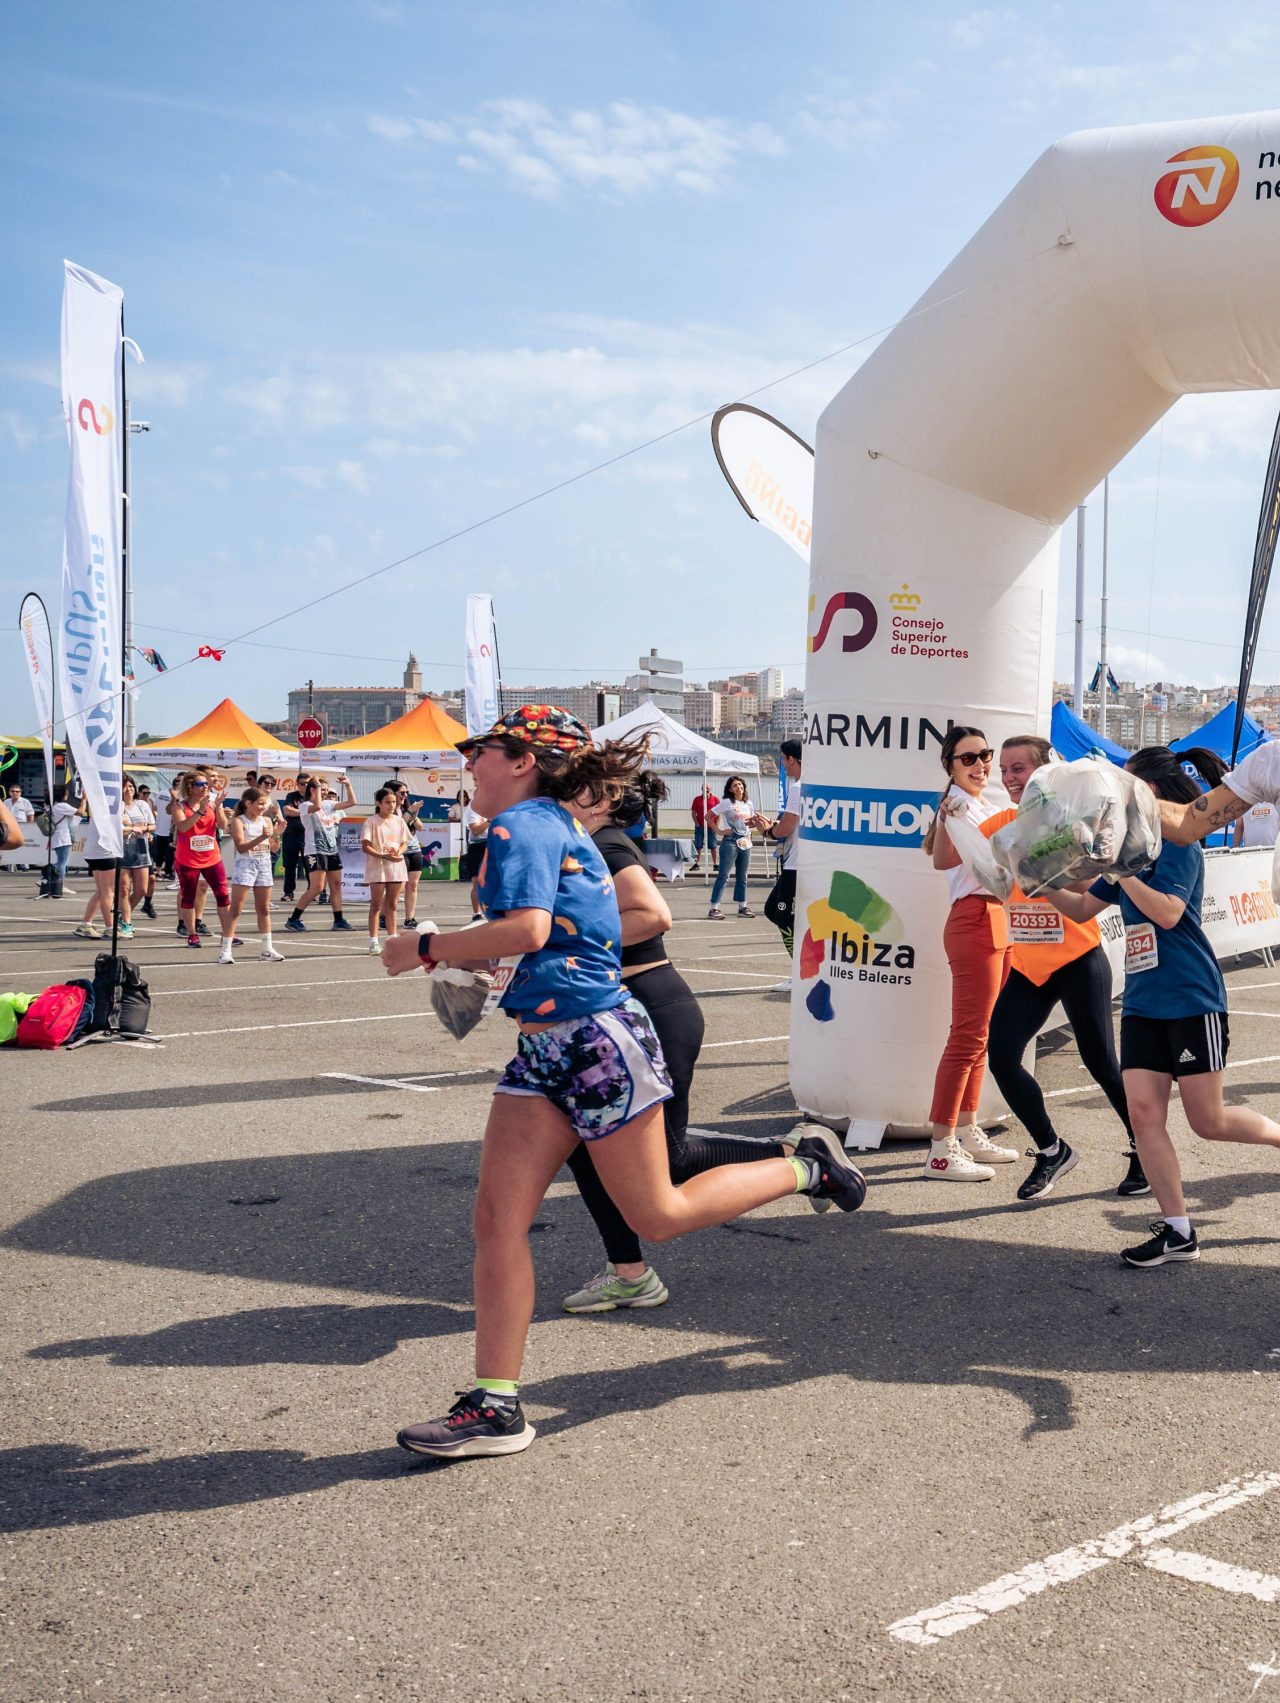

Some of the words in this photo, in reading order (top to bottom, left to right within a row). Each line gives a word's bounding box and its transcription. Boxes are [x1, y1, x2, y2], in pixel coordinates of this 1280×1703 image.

[892, 616, 944, 632] Consejo
[892, 630, 947, 643] Superior
[891, 644, 906, 655] de
[911, 645, 969, 658] Deportes
[298, 730, 321, 738] STOP
[673, 756, 698, 765] ALTAS
[1012, 914, 1057, 927] 20393
[830, 931, 915, 970] Ibiza
[1127, 936, 1152, 955] 394
[829, 965, 855, 981] Illes
[858, 969, 912, 986] Balears
